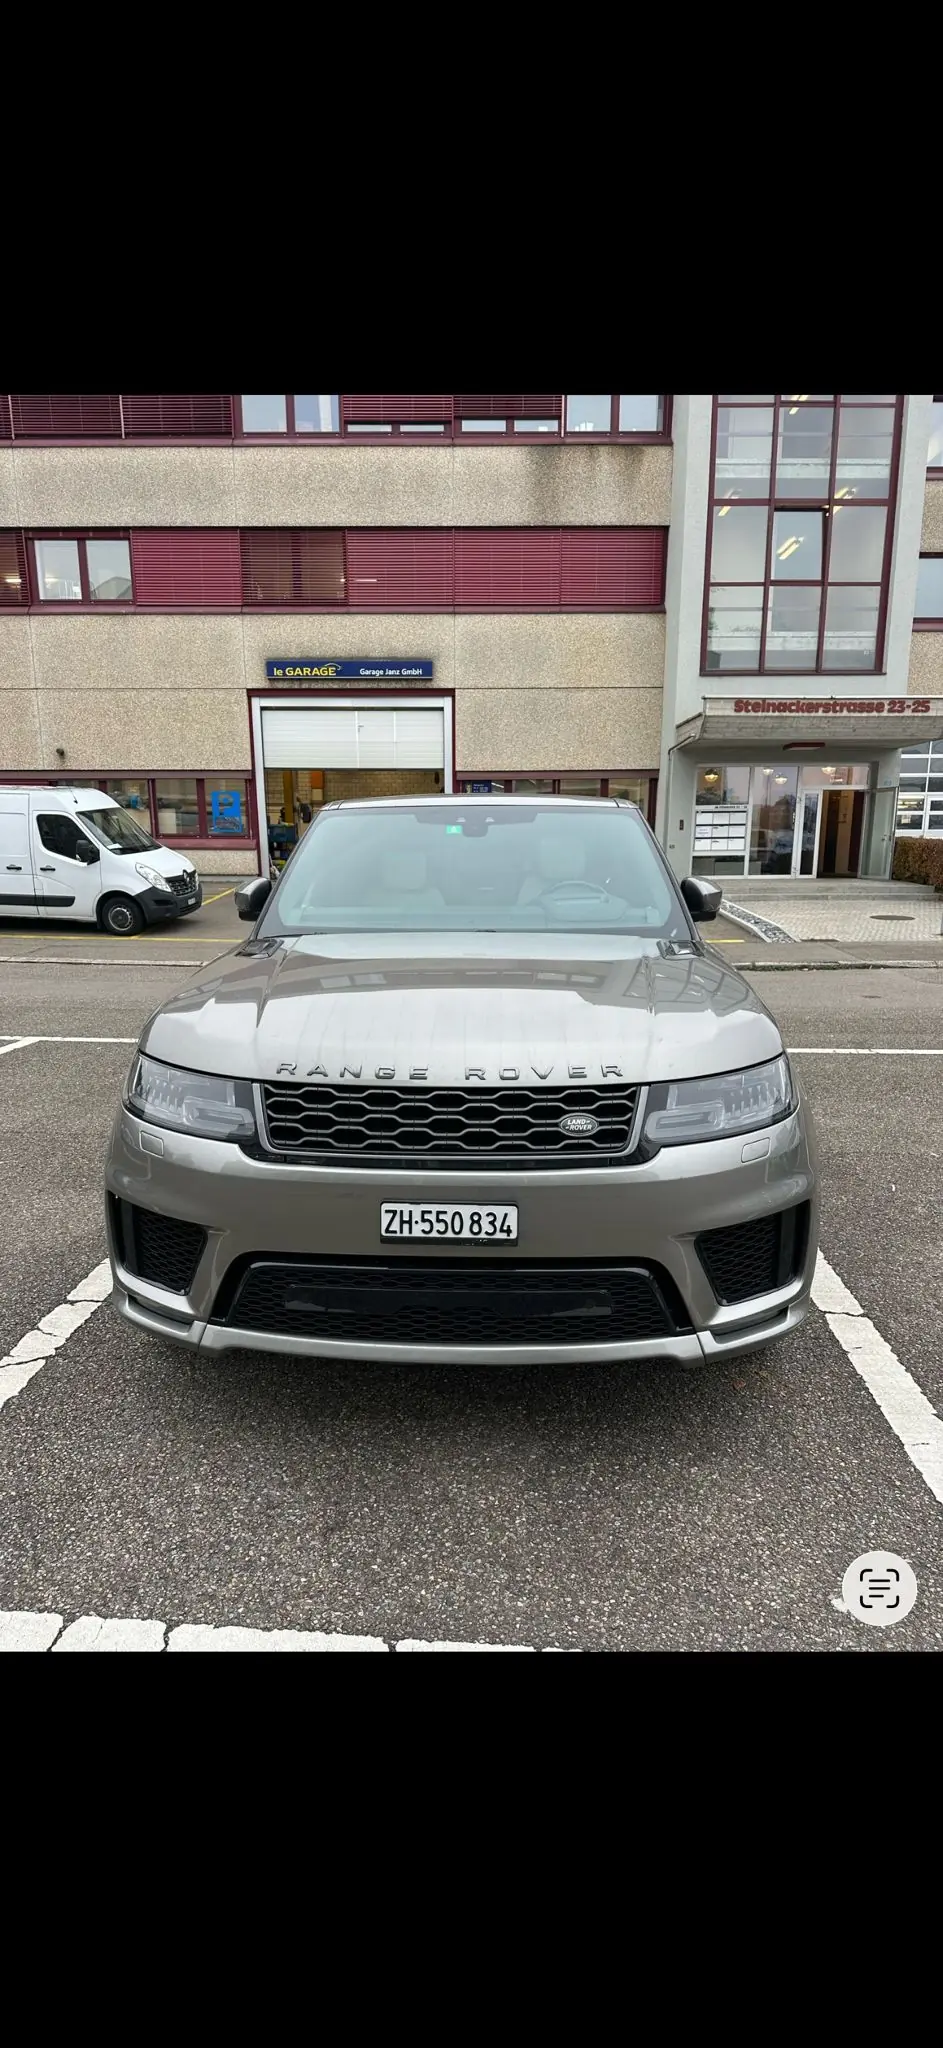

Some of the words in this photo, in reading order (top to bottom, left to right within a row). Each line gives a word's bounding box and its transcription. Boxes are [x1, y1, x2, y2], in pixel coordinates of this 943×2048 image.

[273, 667, 283, 676] le
[285, 667, 337, 676] GARAGE
[359, 668, 384, 677] Garage
[385, 668, 400, 676] Janz
[401, 668, 423, 676] GmbH
[733, 699, 886, 714] Steinackerstrasse
[887, 699, 931, 714] 23-25
[276, 1063, 429, 1080] RANGE
[464, 1064, 624, 1081] ROVER
